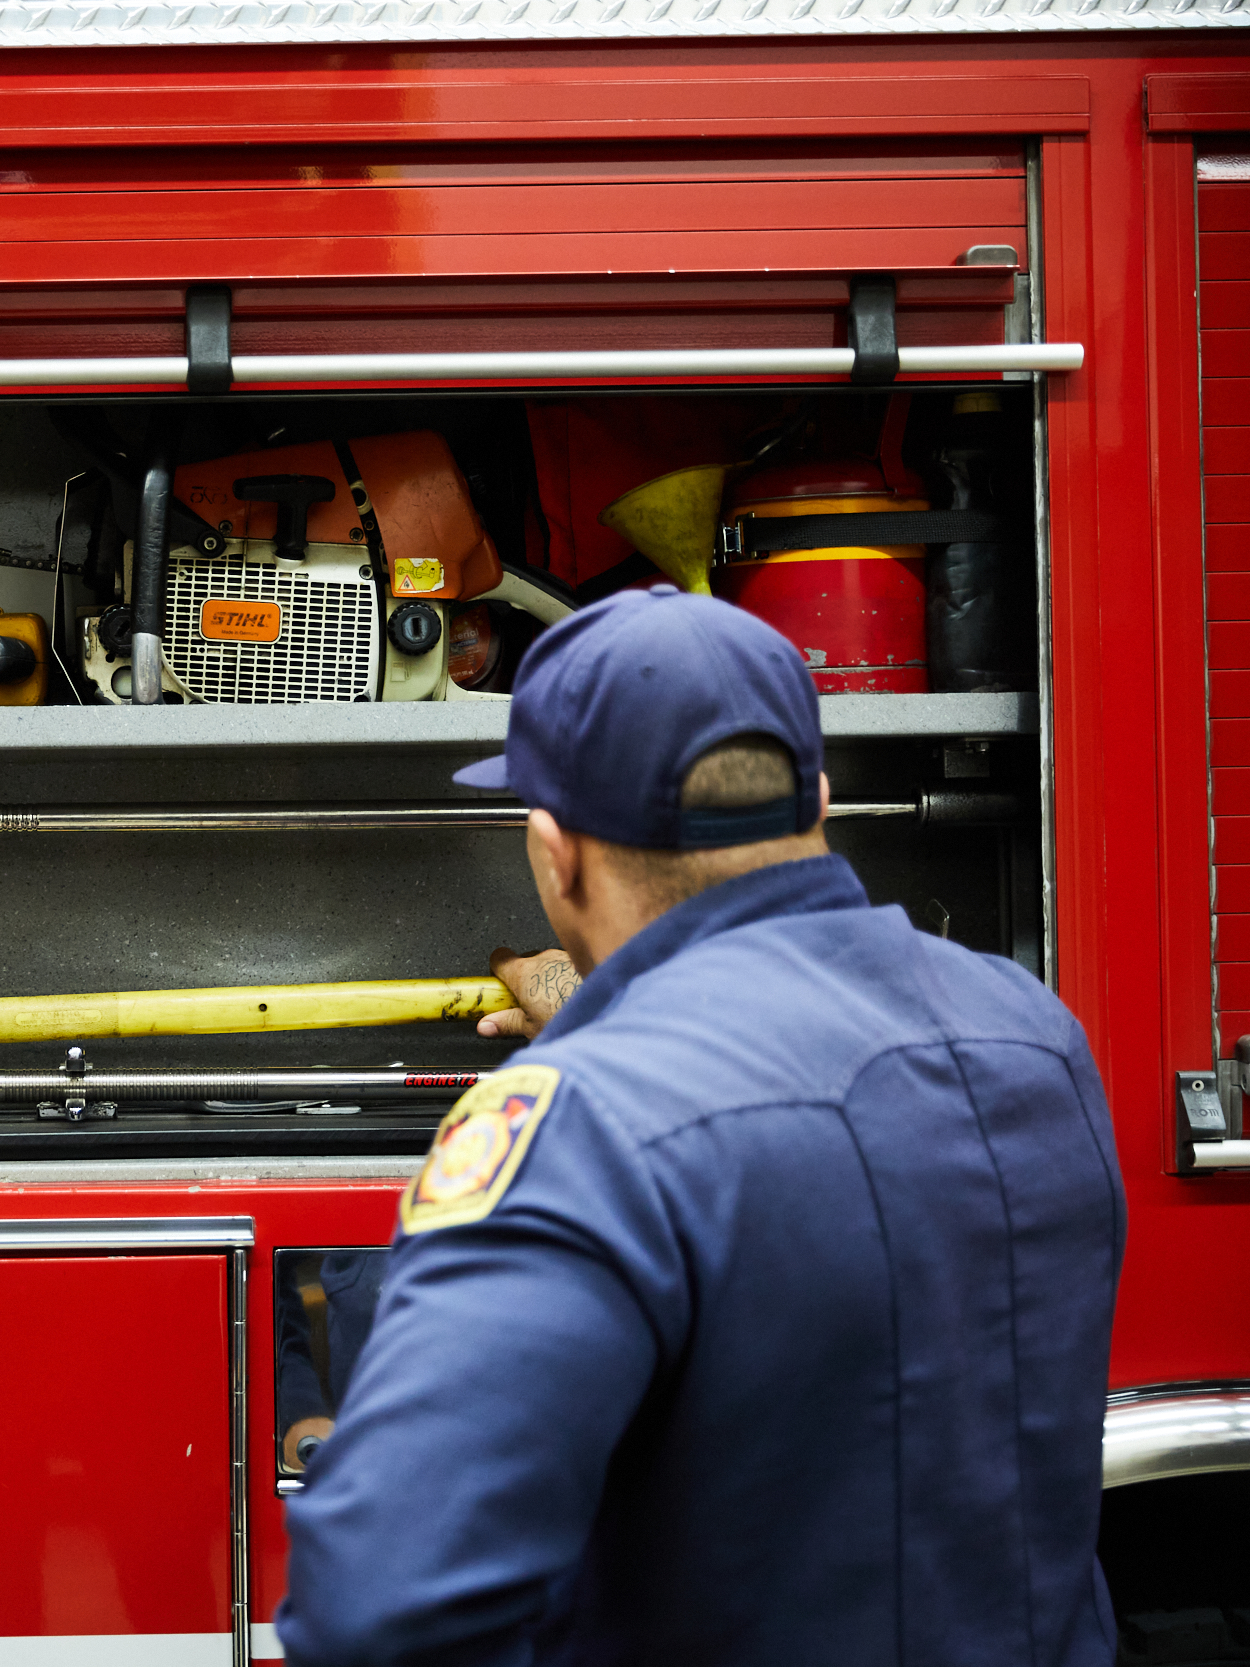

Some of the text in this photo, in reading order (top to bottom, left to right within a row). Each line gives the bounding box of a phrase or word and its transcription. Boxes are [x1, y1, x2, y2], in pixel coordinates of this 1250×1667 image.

[211, 611, 266, 628] STIHL
[405, 1072, 478, 1087] ENGINE 72
